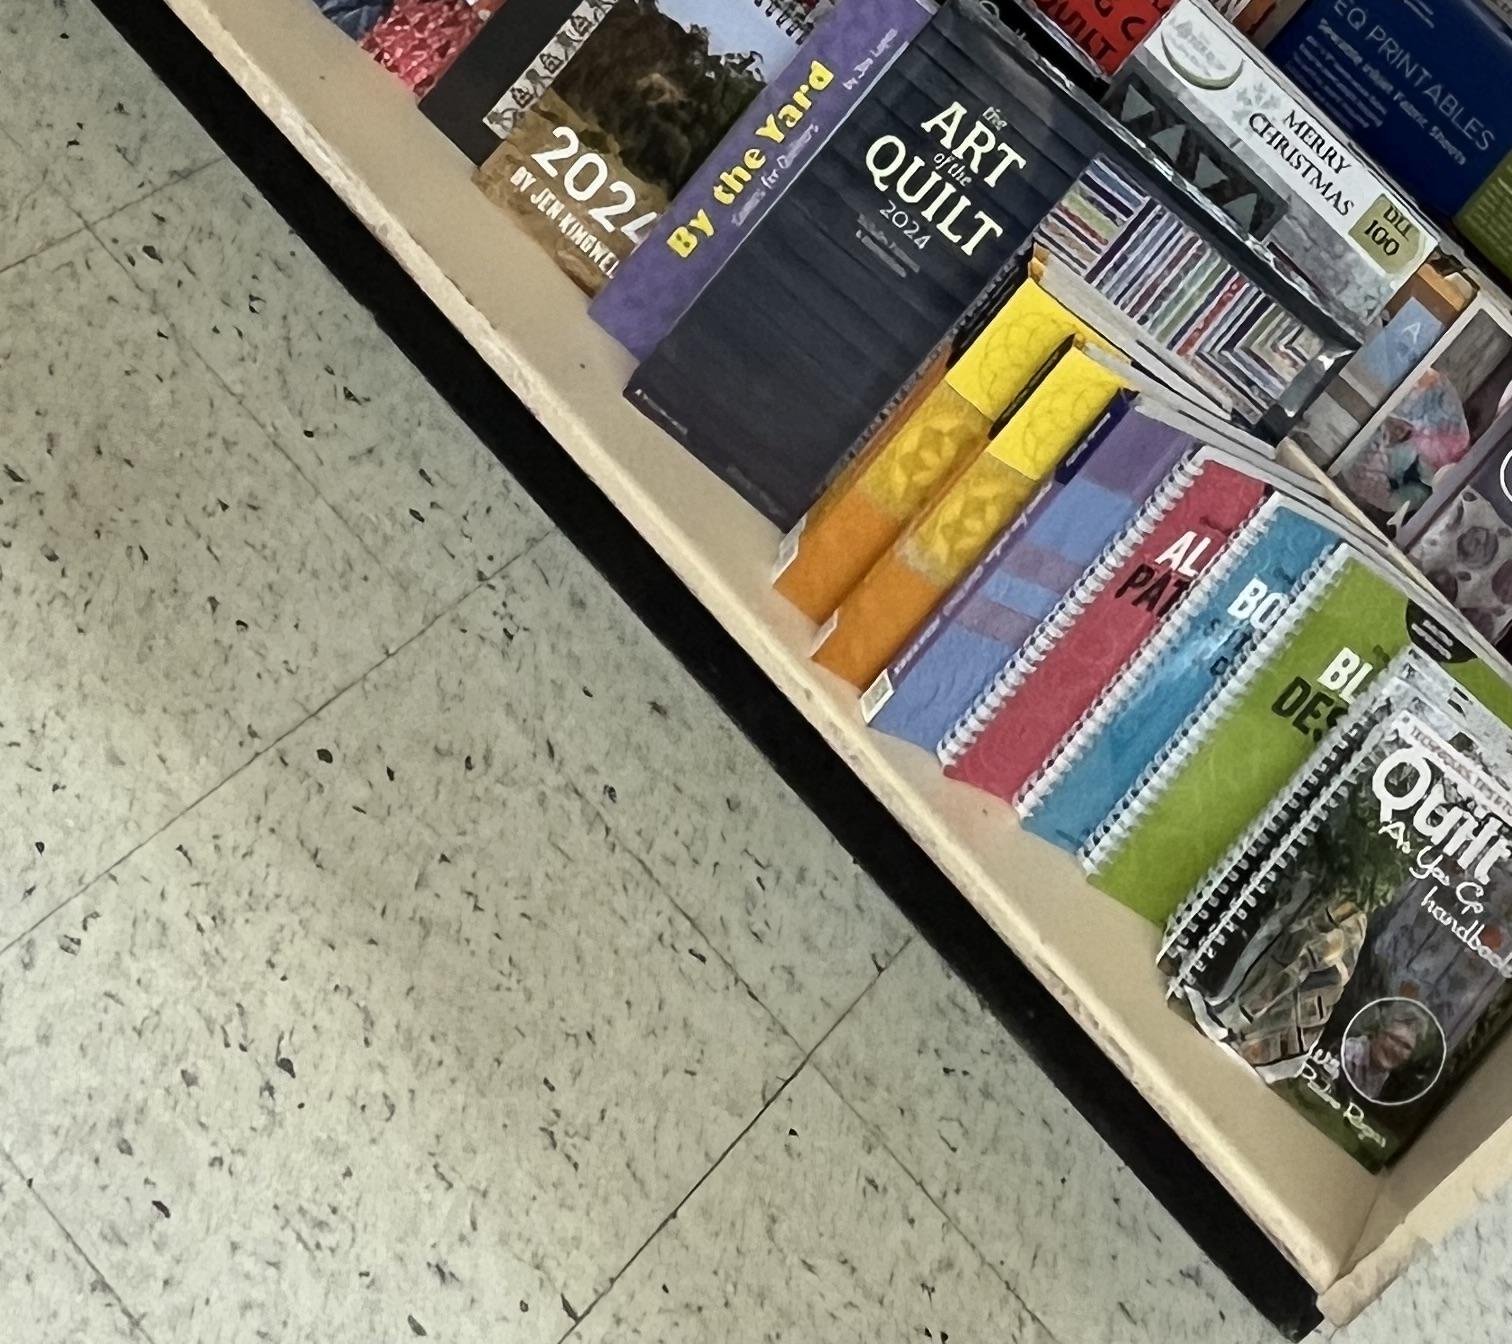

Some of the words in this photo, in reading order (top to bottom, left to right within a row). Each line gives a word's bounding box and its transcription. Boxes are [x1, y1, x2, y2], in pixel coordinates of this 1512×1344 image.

[1367, 27, 1497, 152] PRINTABLES
[667, 208, 715, 259] By
[713, 148, 767, 205] the
[755, 59, 835, 144] Yard
[921, 100, 1027, 189] ART
[934, 151, 952, 171] of
[947, 160, 975, 187] the
[1248, 112, 1355, 218] CHRISTMAS
[1282, 109, 1353, 174] MERRY
[866, 134, 1004, 257] QUILT
[878, 204, 933, 251] 2024
[1363, 218, 1401, 256] 100
